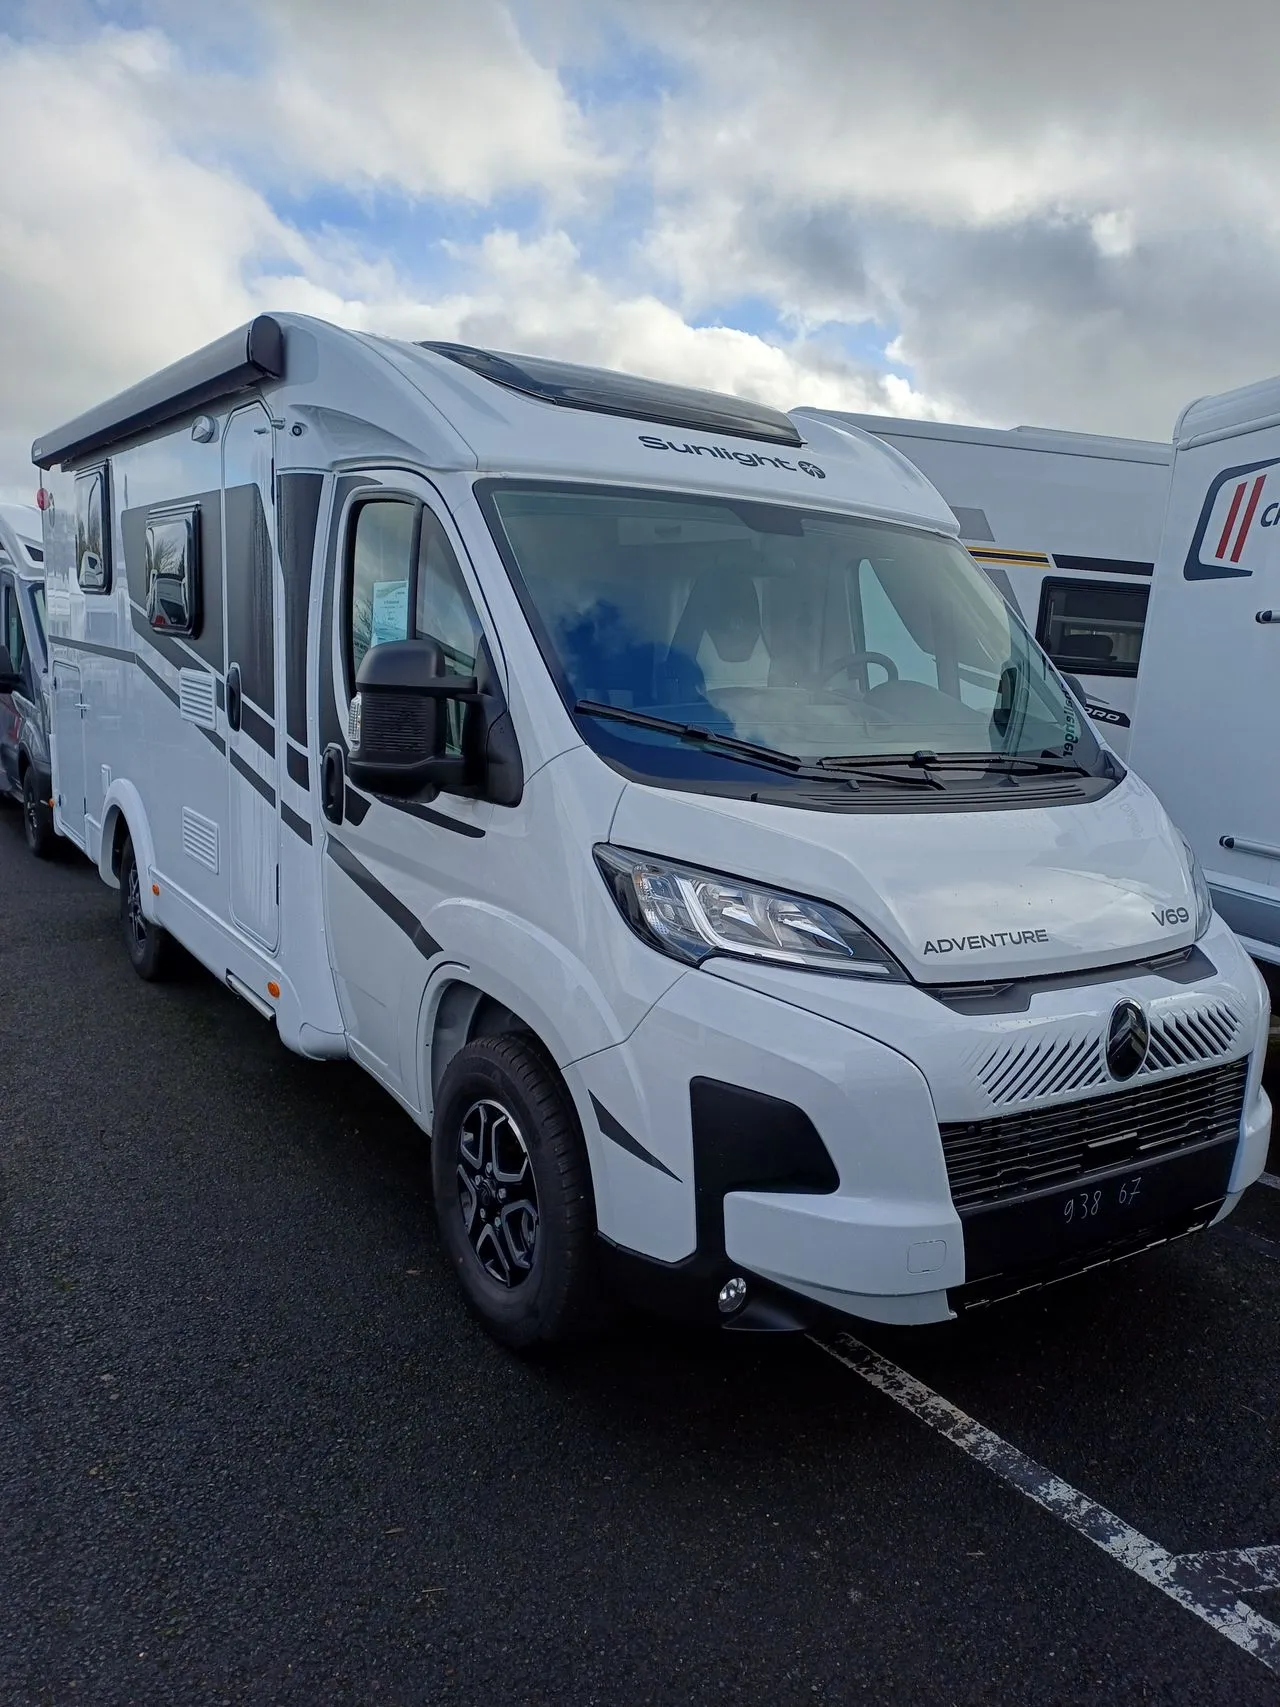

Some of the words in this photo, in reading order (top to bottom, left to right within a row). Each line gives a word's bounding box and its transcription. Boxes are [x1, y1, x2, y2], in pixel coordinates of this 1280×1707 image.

[638, 435, 797, 472] Sunlight
[1151, 906, 1190, 927] V69
[923, 929, 1049, 955] ADVENTURE
[1063, 1190, 1102, 1224] 938
[1118, 1176, 1142, 1205] 67
